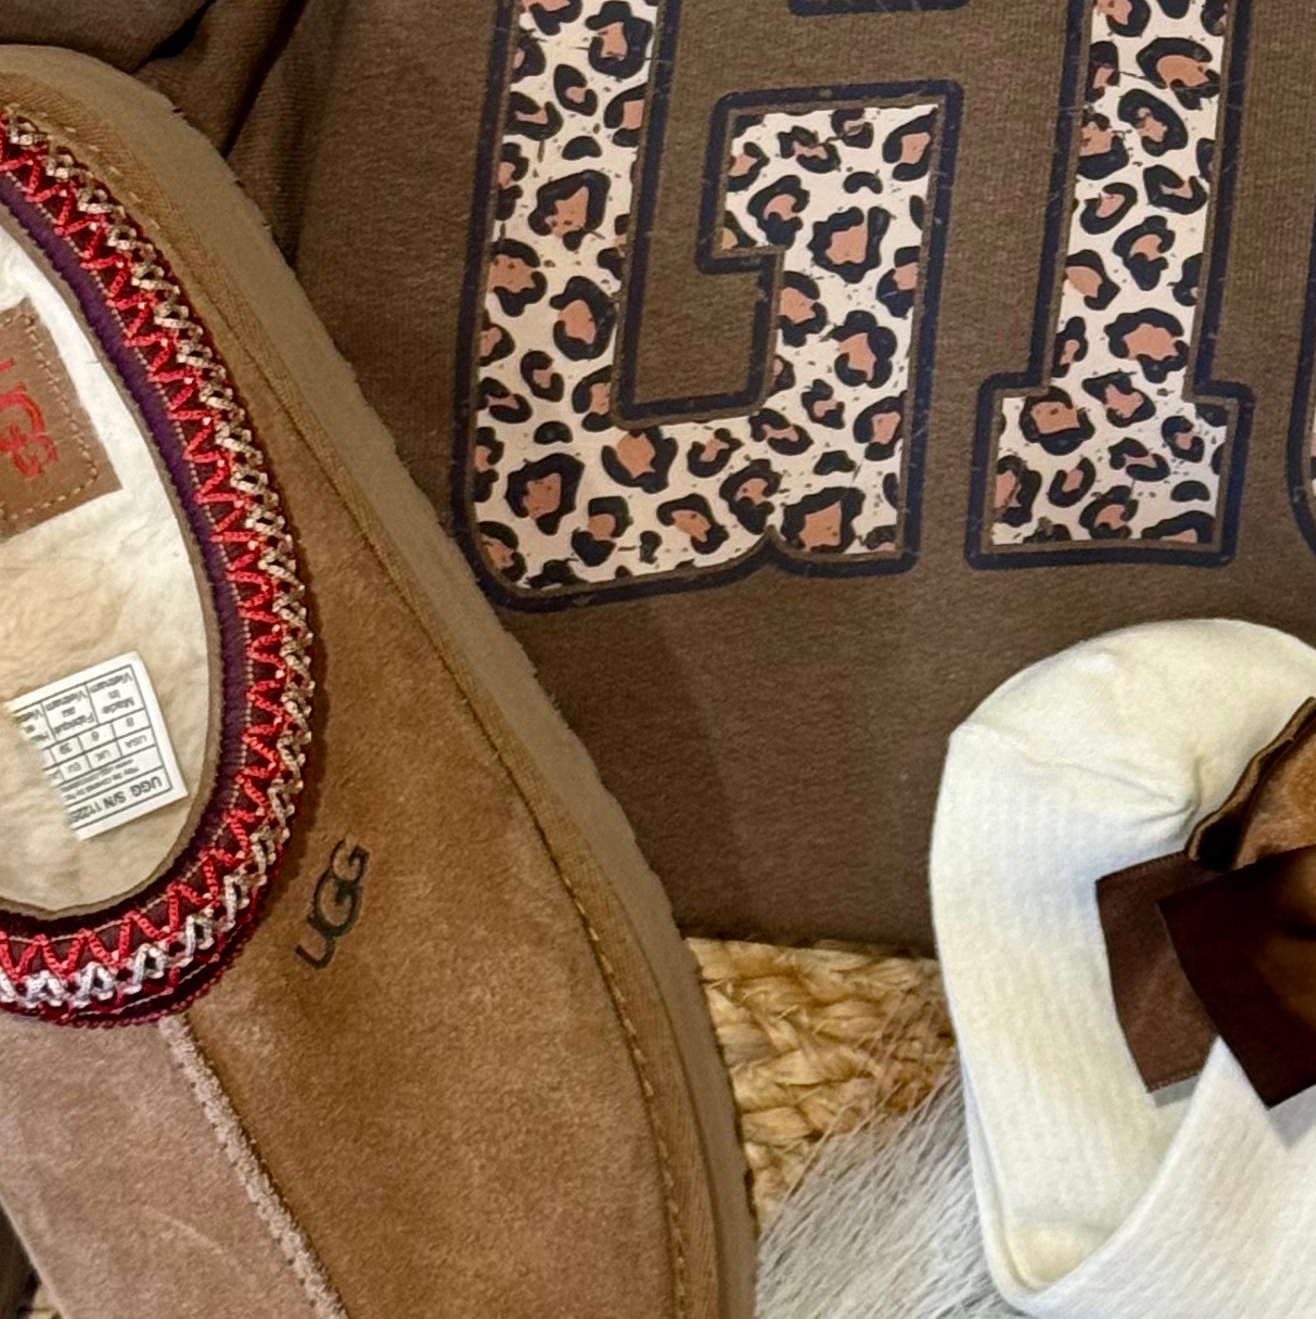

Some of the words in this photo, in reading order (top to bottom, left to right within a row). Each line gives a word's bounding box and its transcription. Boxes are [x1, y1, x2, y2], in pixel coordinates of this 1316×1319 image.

[0, 358, 59, 476] GG
[130, 775, 163, 798] UGG
[295, 839, 370, 973] UGG
